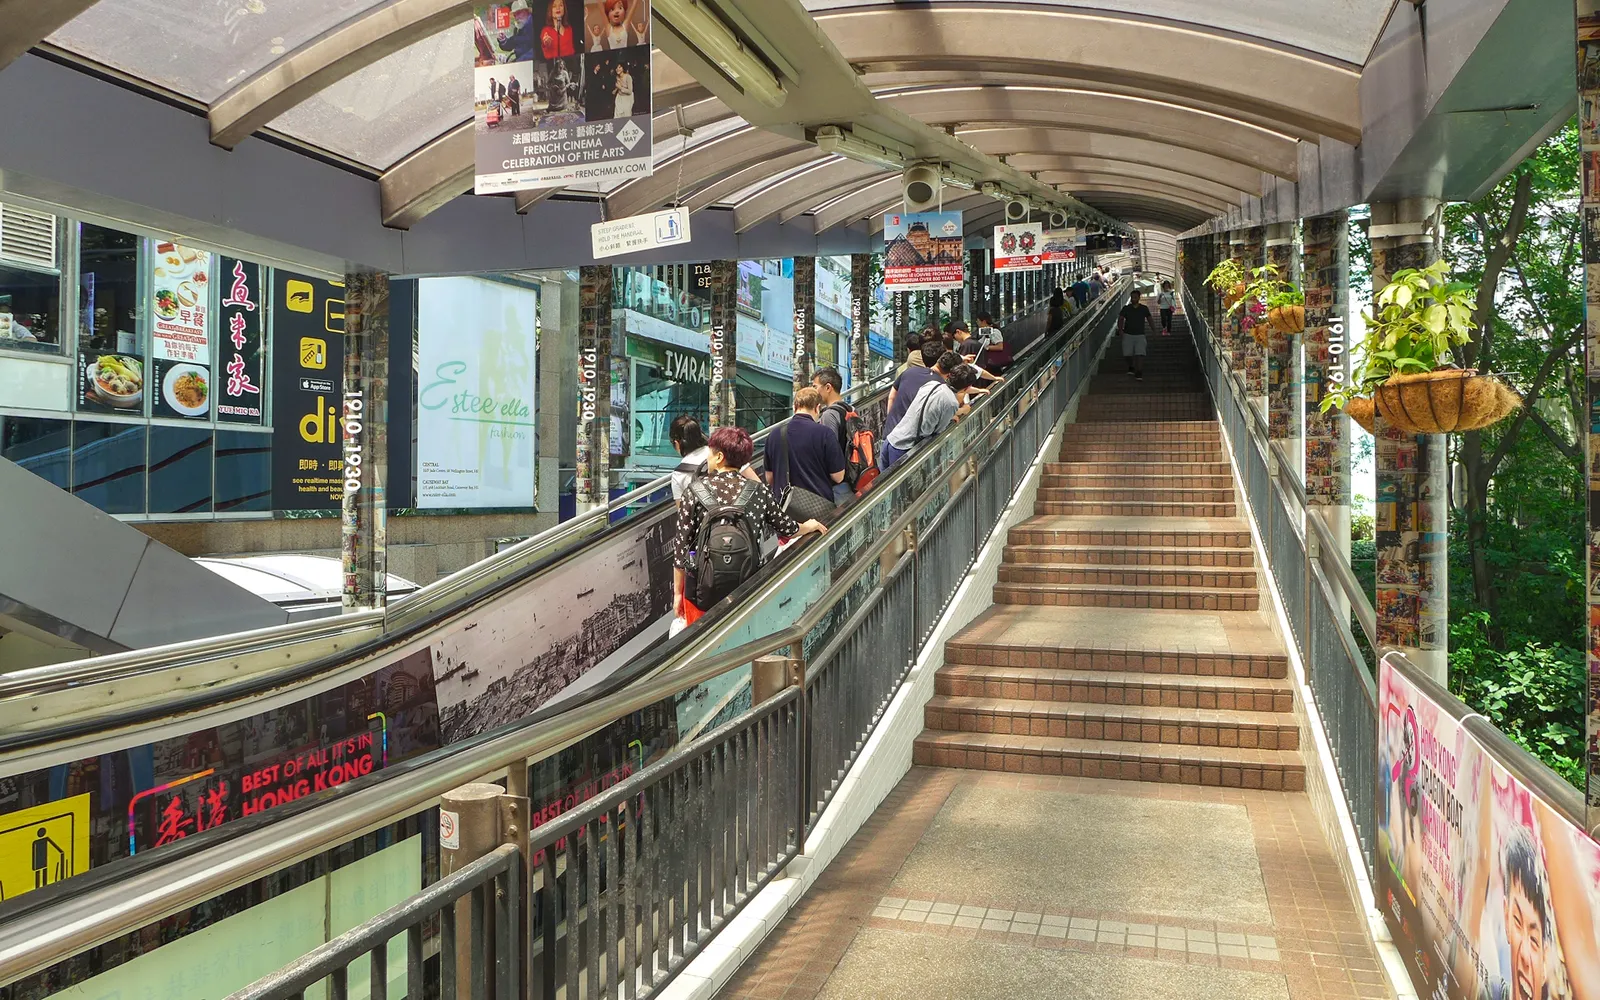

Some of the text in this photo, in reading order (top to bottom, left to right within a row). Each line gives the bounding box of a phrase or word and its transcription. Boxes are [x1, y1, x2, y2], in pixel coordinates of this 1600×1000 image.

[512, 122, 614, 145] 法國電影之旅：藝術之美
[523, 137, 603, 156] FRENCH CINEMA
[623, 135, 638, 143] MAY
[502, 147, 625, 170] CELEBRATION OF THE ARTS
[575, 163, 647, 179] FRENCHMAY.COM
[694, 264, 712, 275] na
[698, 276, 712, 288] sp
[180, 309, 204, 327] 早餐
[796, 308, 805, 356] 1930-1960
[853, 298, 861, 338] 1930-1960
[665, 350, 707, 385] IYARA
[713, 324, 724, 382] 1910-1930
[1328, 315, 1344, 405] 1910-193
[582, 347, 597, 420] 1910-1930
[299, 395, 345, 444] di
[344, 390, 363, 492] 1910-1930
[242, 731, 373, 794] BEST OF ALL IT'S IN
[1420, 724, 1456, 790] HONG KONG
[242, 753, 373, 818] HONG KONG
[1421, 759, 1464, 838] DRAGON BOAT
[533, 799, 562, 831] BEST
[564, 789, 580, 811] OF
[1421, 794, 1450, 861] CARNIVAL
